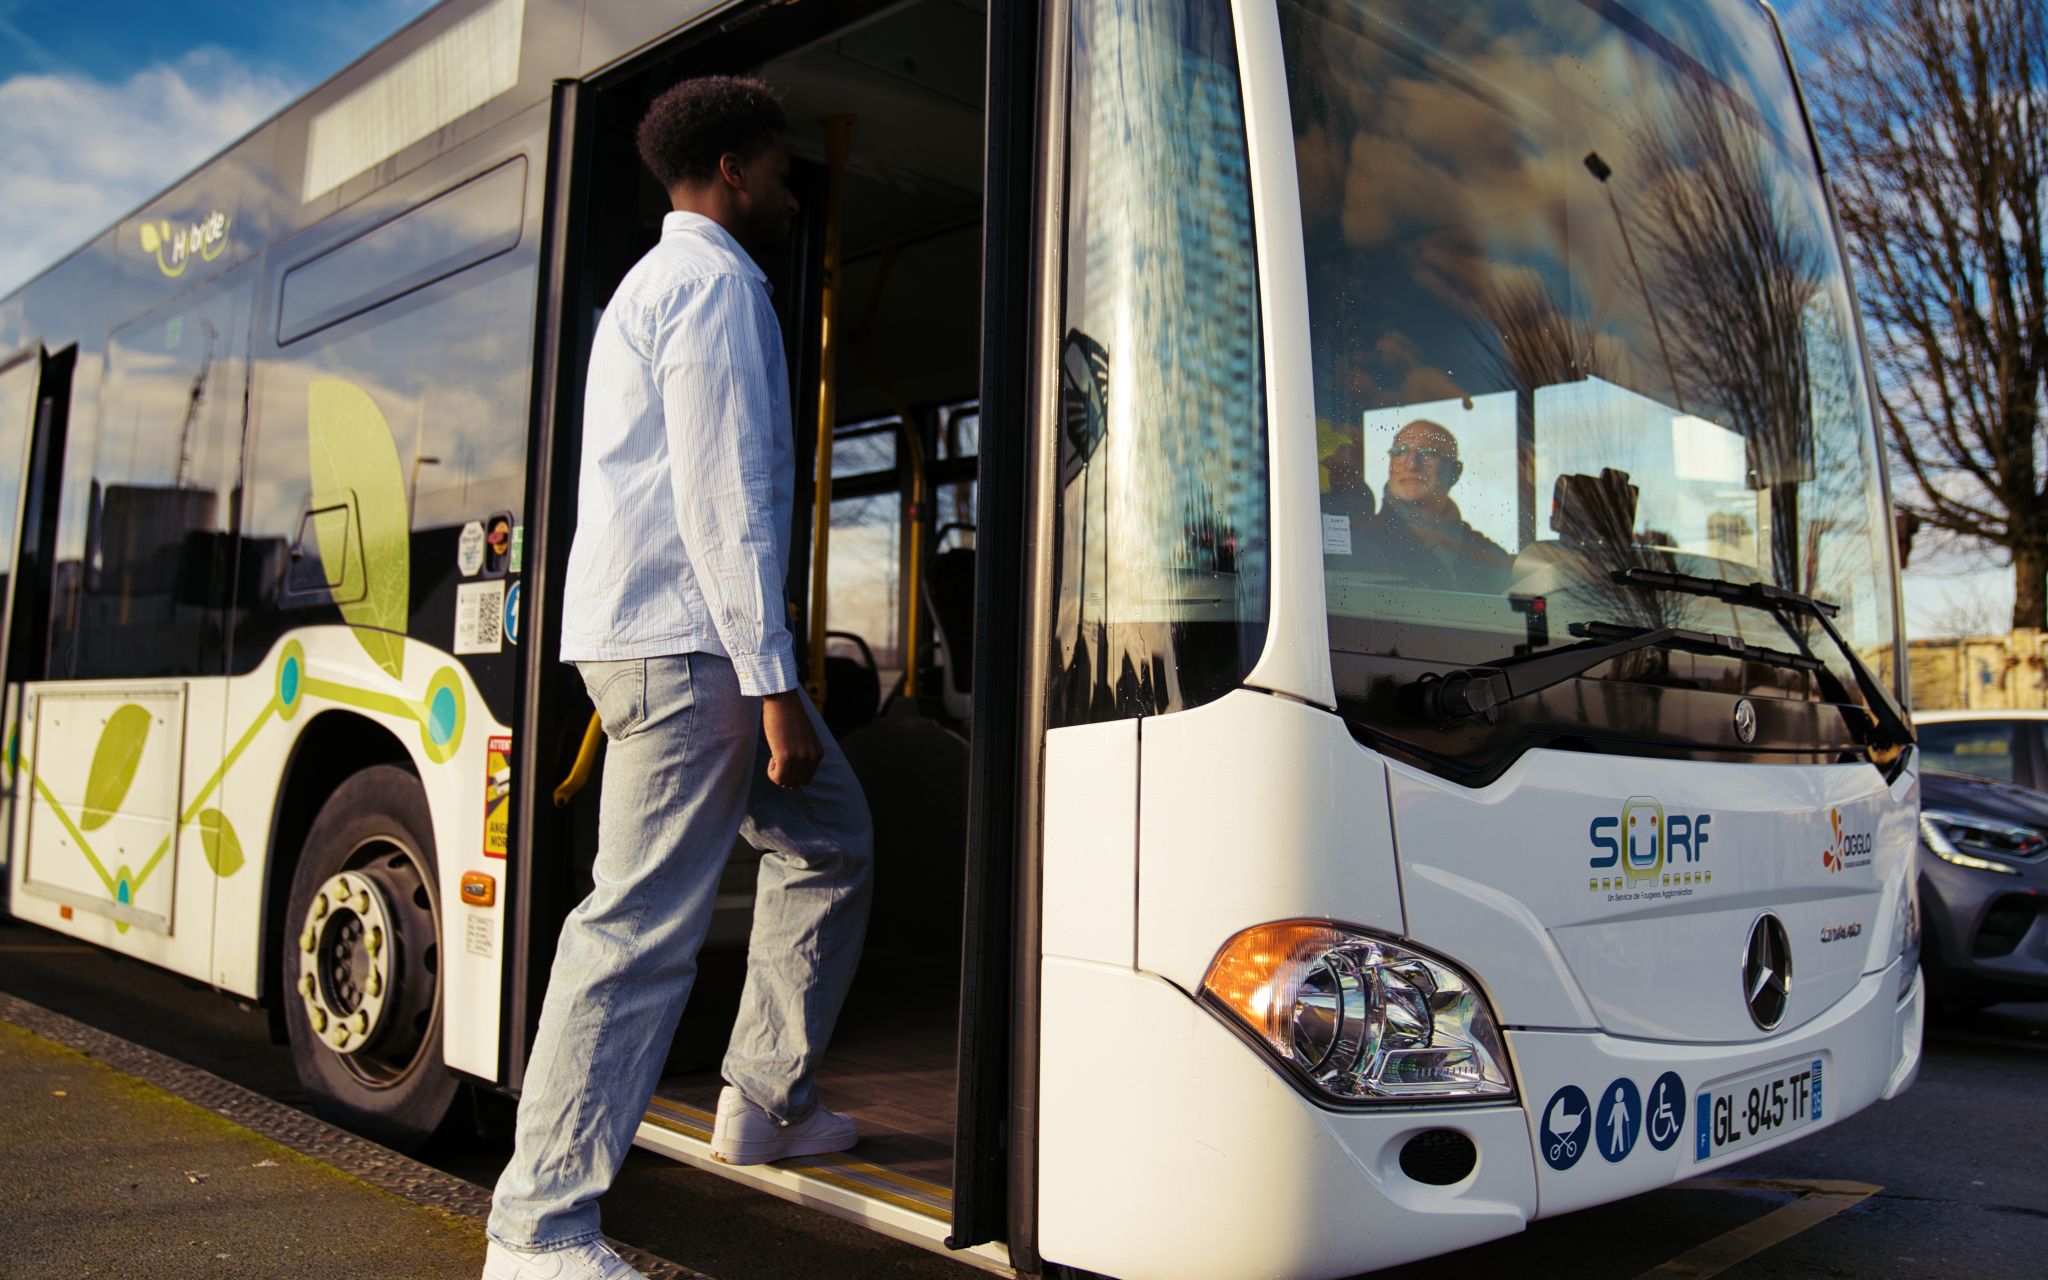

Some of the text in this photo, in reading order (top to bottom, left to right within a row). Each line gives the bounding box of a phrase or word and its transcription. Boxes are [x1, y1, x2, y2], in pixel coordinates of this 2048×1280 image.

[1615, 893, 1632, 901] Service
[1701, 1133, 1706, 1148] F
[1715, 1072, 1811, 1147] GL-845-TF
